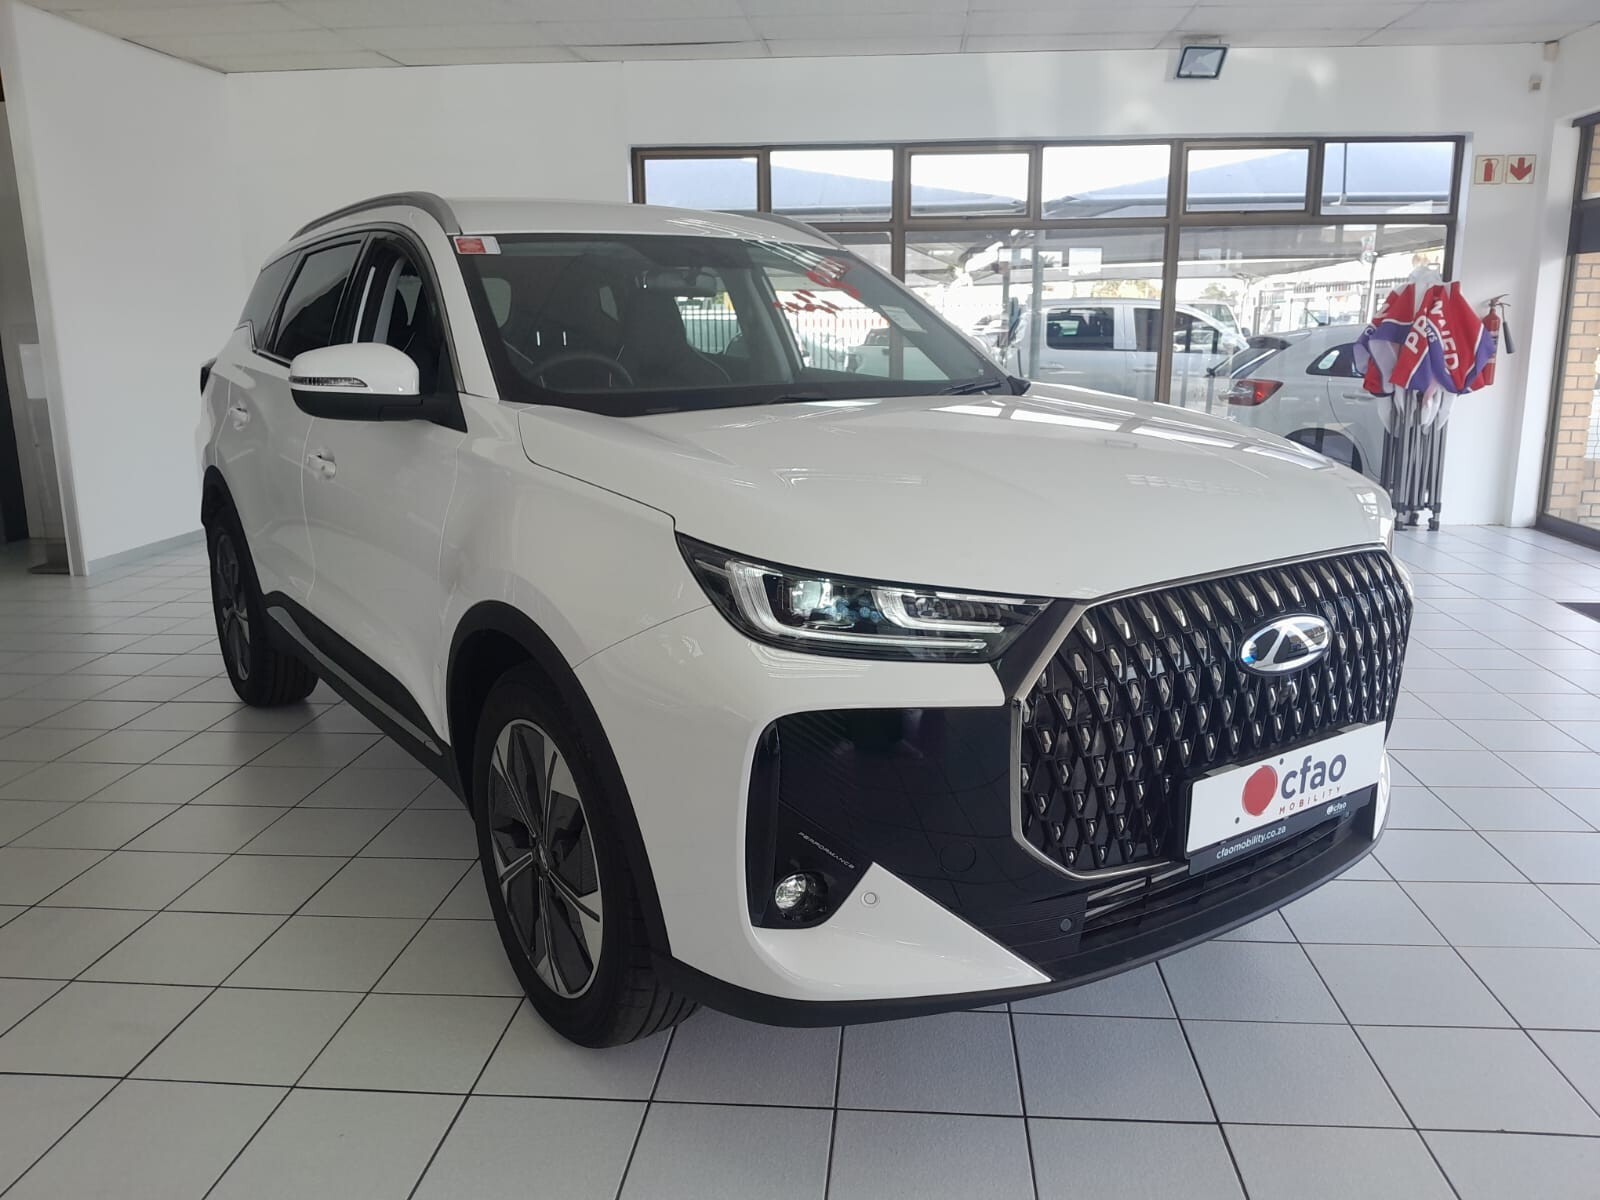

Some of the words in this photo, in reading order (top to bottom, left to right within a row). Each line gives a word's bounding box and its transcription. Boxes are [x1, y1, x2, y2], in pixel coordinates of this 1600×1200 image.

[1281, 754, 1347, 800] cfao
[1279, 786, 1342, 815] MOBILITY
[1216, 825, 1286, 860] cfaomobility.co.za
